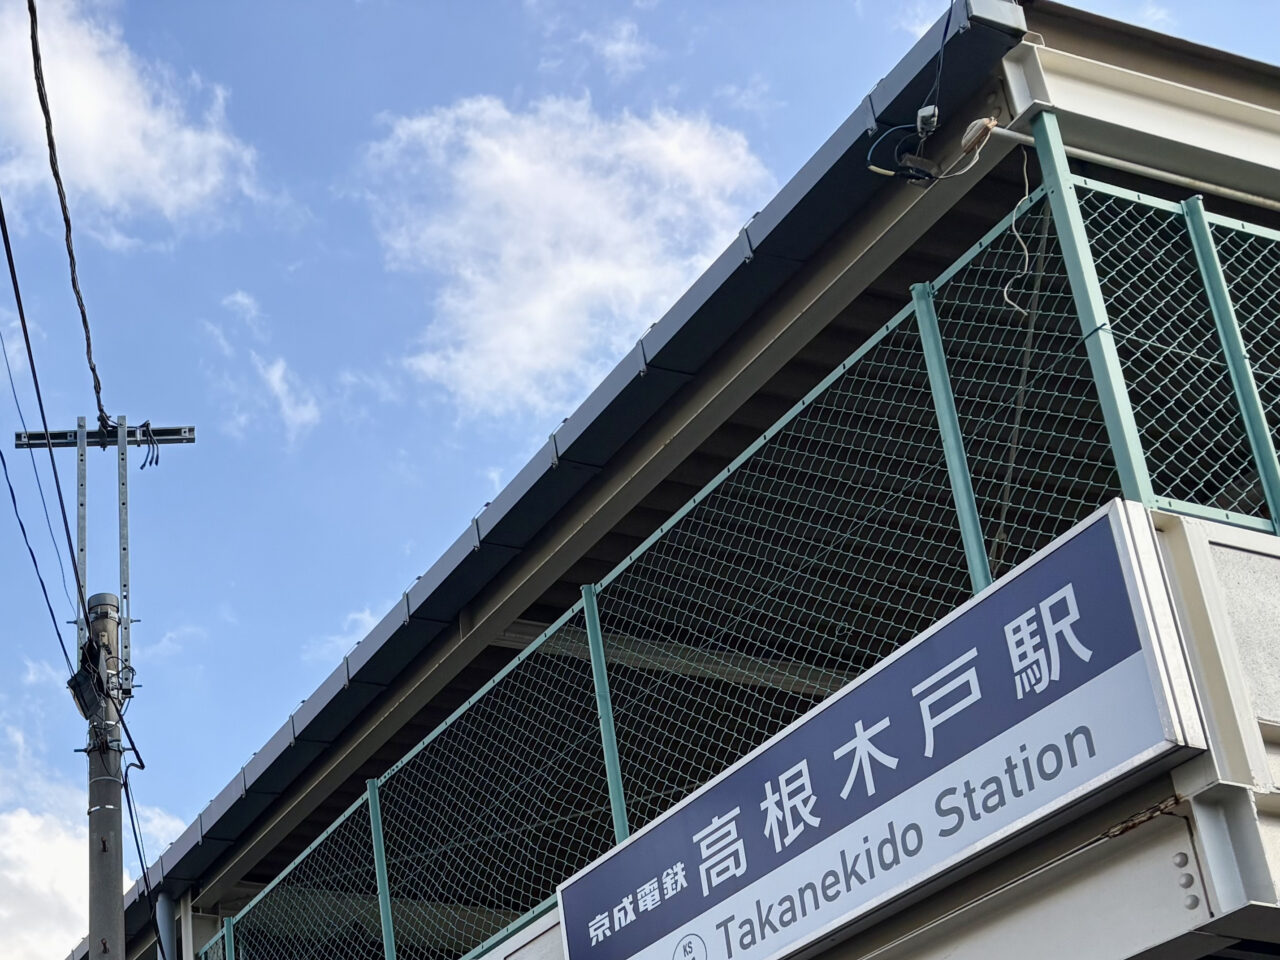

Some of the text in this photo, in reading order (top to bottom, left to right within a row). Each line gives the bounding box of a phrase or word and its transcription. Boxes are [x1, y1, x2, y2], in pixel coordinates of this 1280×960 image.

[587, 582, 1094, 947] 京成電鉄 高根木戸駅
[715, 723, 1097, 960] Takanekido Station
[682, 940, 693, 957] KS
